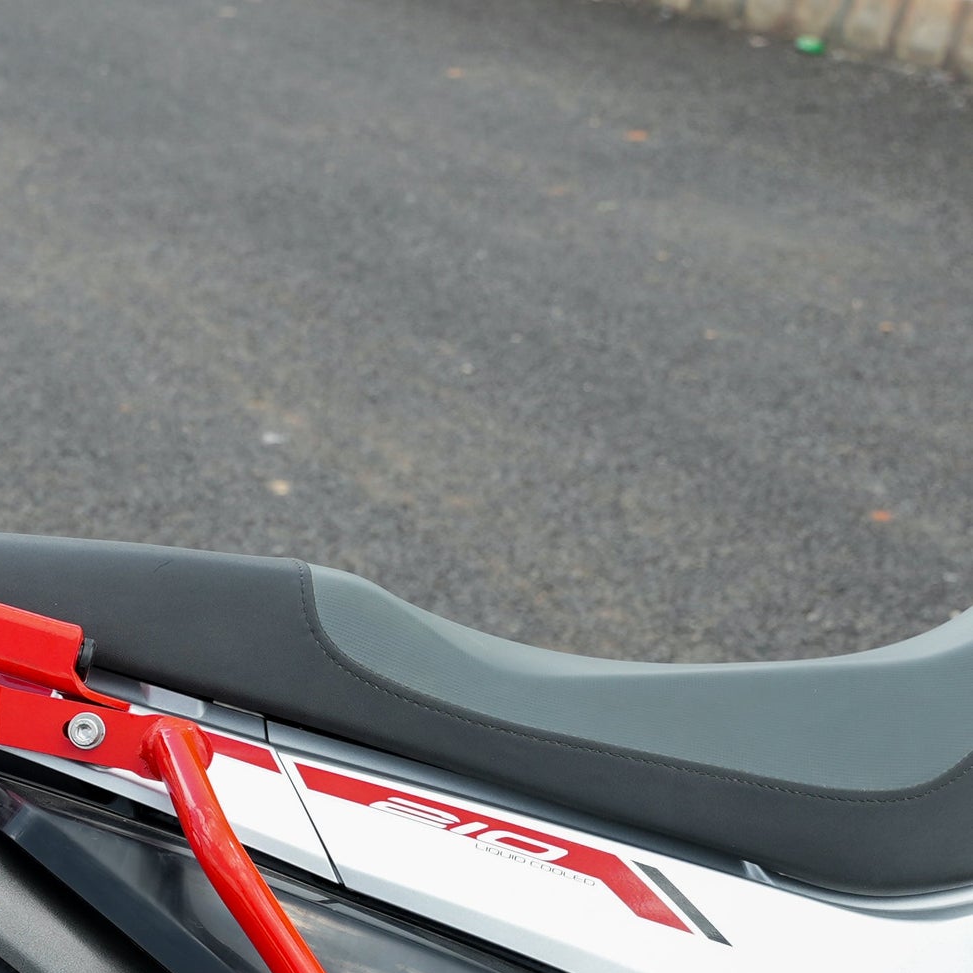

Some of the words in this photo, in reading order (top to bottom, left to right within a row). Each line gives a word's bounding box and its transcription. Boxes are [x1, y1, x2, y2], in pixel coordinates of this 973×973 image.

[369, 796, 569, 862] 210
[475, 843, 526, 864] LIQUID
[530, 860, 595, 887] COOLED
